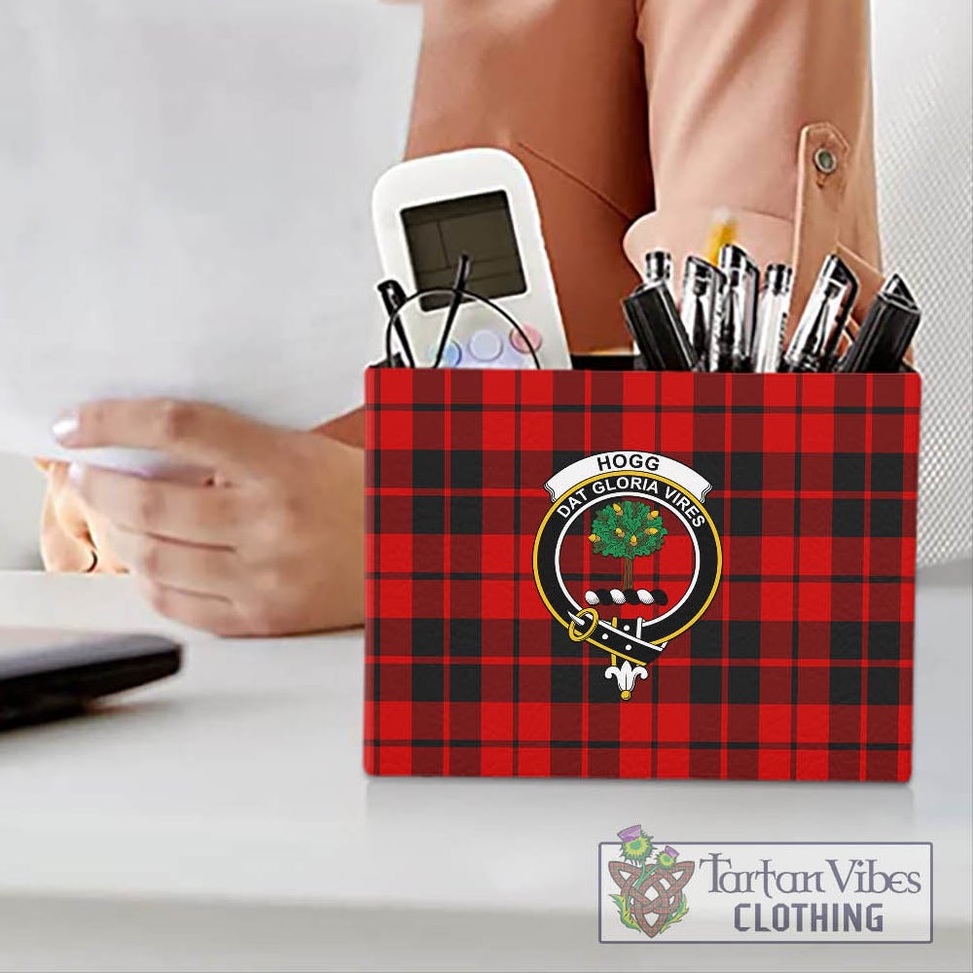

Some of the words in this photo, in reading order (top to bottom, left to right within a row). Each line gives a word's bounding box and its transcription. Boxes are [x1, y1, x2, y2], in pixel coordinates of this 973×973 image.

[597, 454, 660, 471] HOGG
[556, 489, 589, 518] DAT
[592, 477, 659, 495] GLORIA
[664, 486, 706, 528] VIRES
